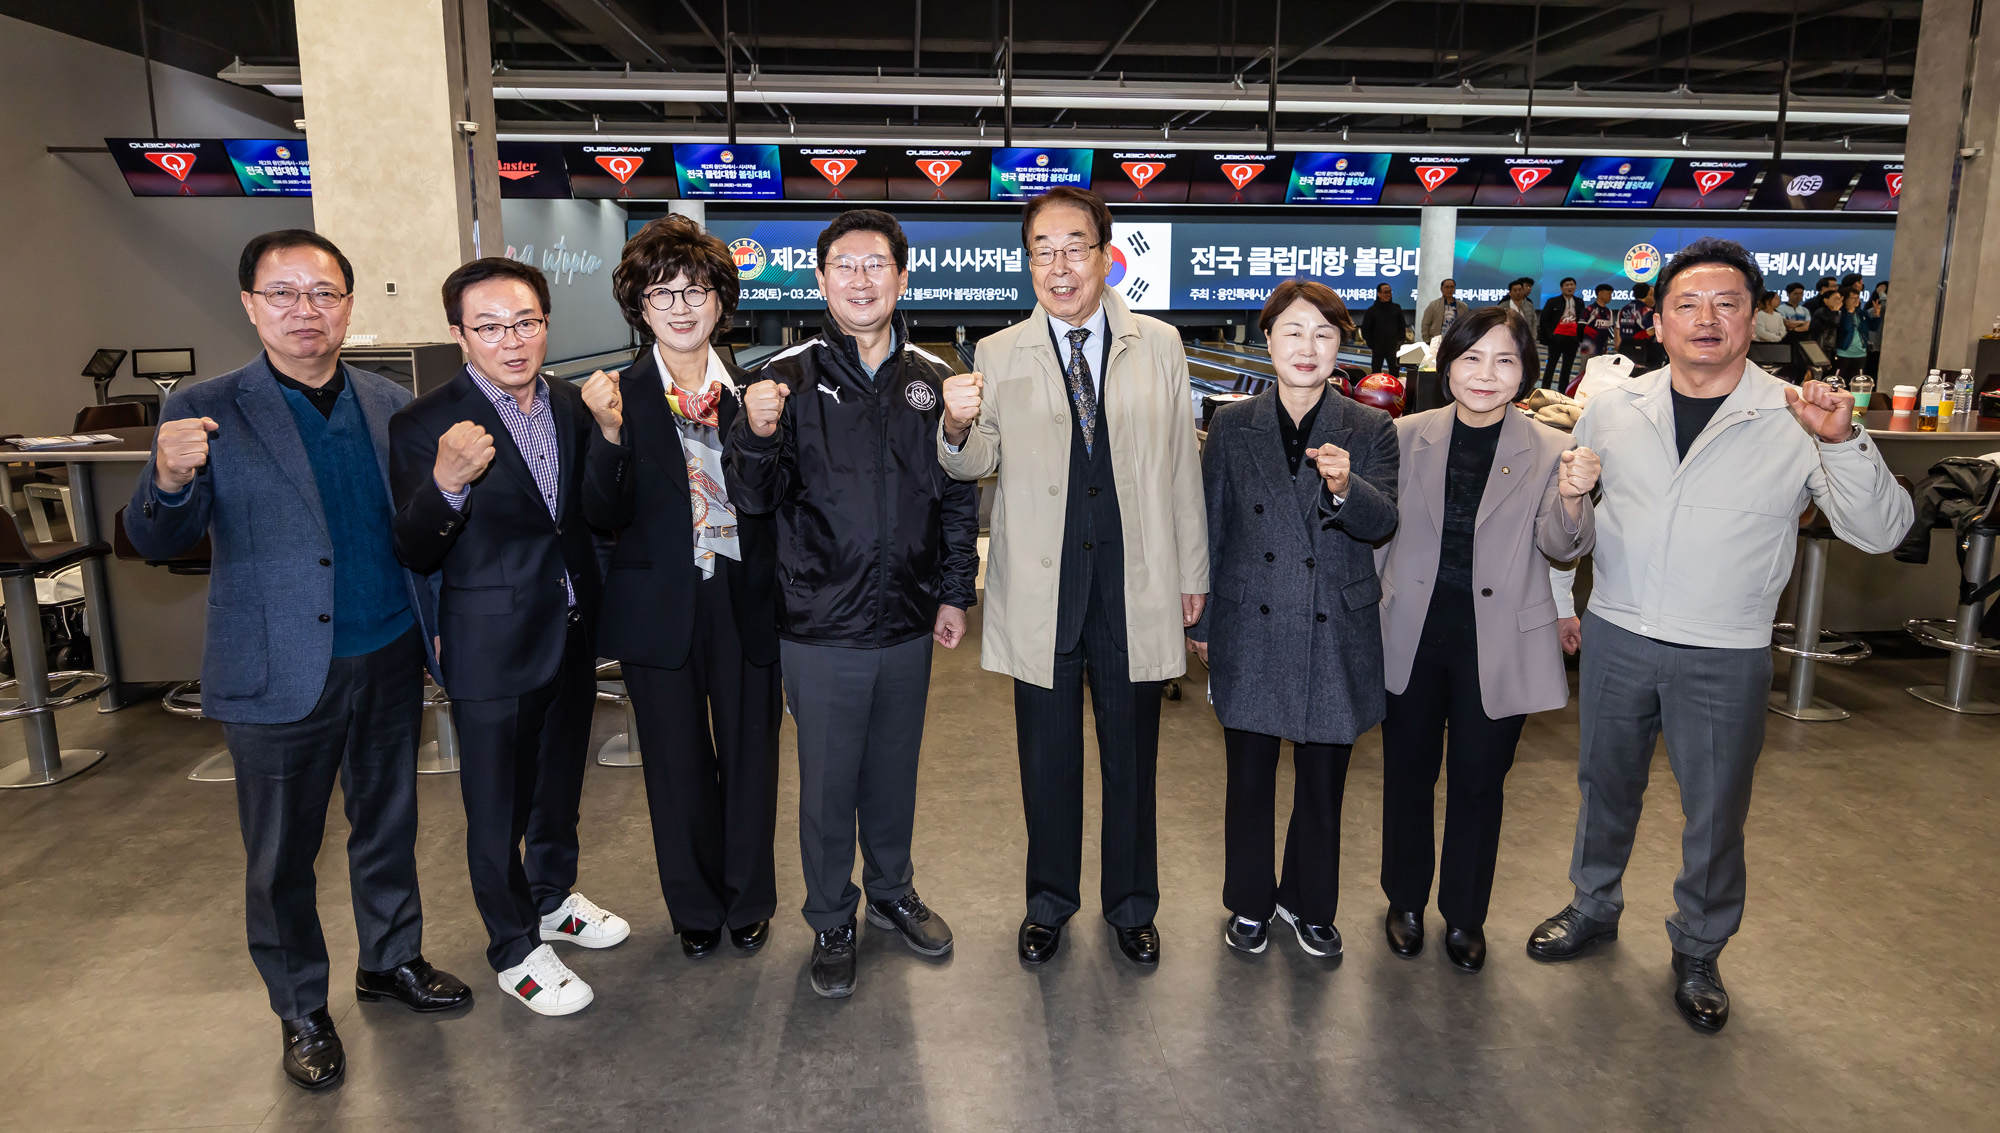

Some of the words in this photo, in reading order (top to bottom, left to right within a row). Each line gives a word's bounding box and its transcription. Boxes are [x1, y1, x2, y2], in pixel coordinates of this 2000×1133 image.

[687, 169, 704, 179] 전국
[705, 169, 737, 179] 클럽대항
[739, 170, 771, 179] 볼링대회
[1001, 172, 1016, 181] 전국
[1018, 173, 1048, 182] 클럽대항
[1050, 174, 1080, 182] 볼링대회
[1790, 180, 1821, 191] VISE
[734, 254, 756, 264] YIBA
[940, 247, 1022, 272] 시사저널
[1190, 246, 1242, 276] 전국
[1248, 246, 1348, 276] 클럽대항
[1752, 252, 1805, 276] 특례시
[1808, 252, 1878, 276] 시사저널
[914, 288, 953, 300] 볼토피아
[1190, 288, 1209, 300] 주최
